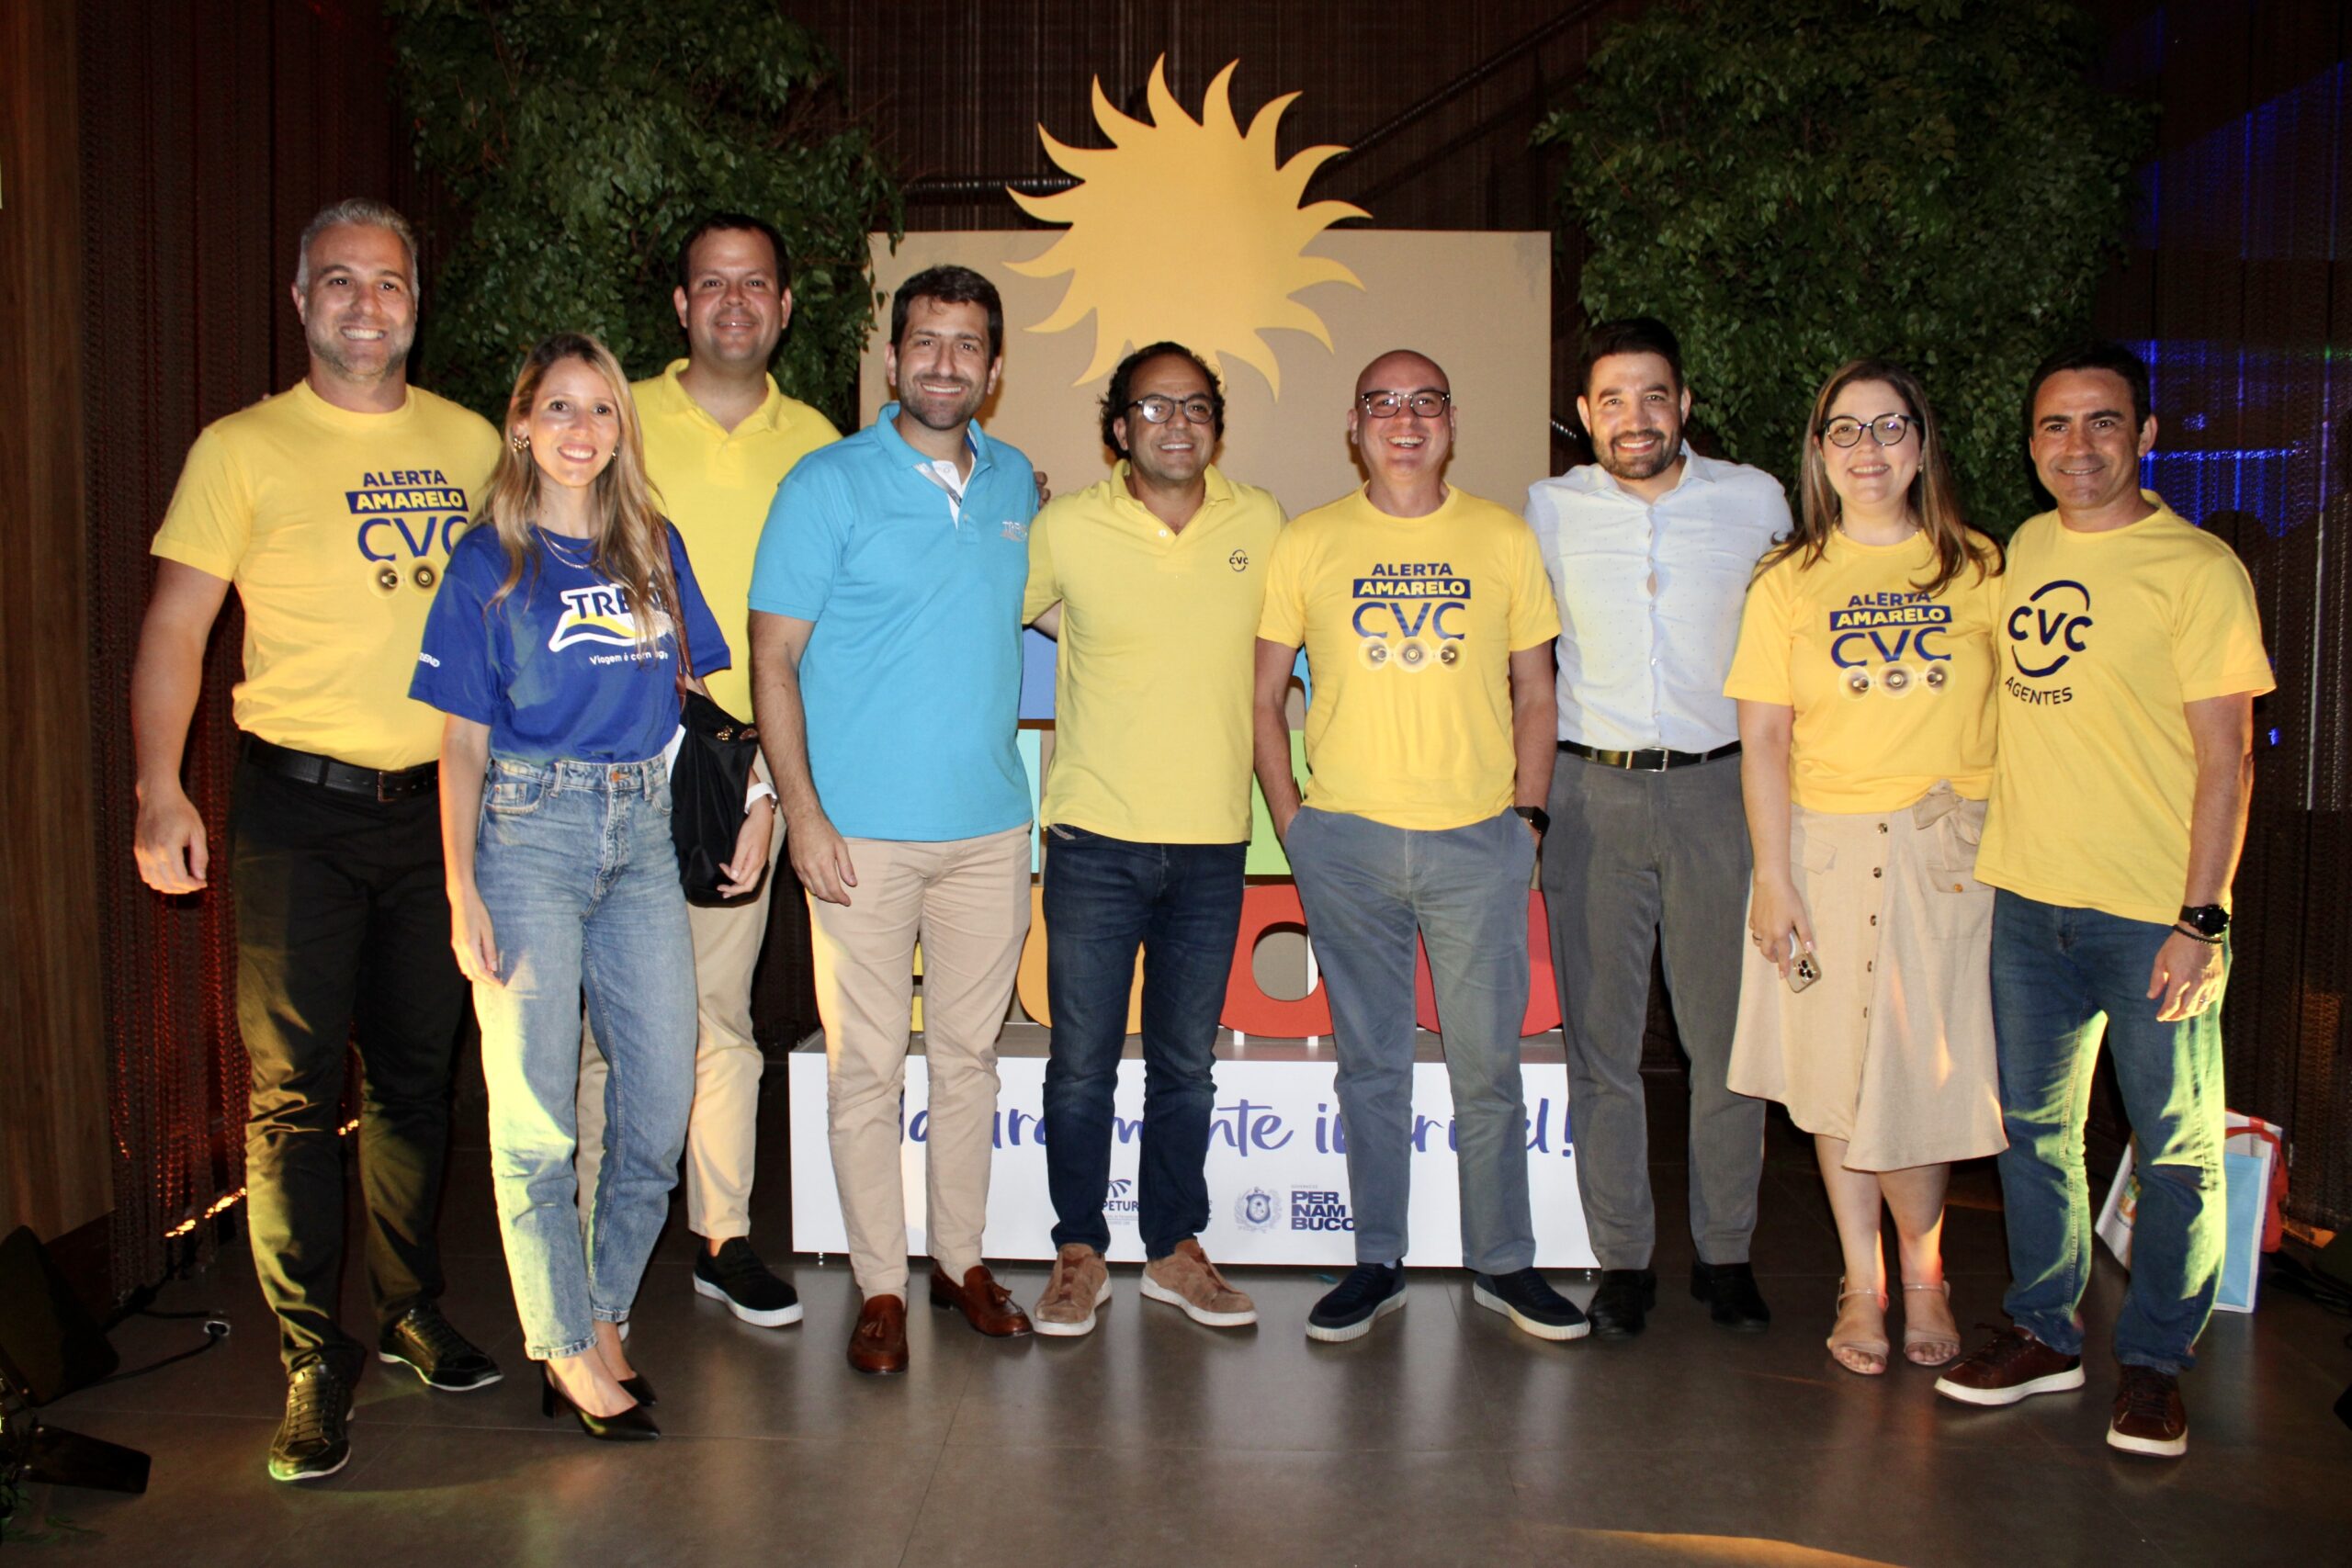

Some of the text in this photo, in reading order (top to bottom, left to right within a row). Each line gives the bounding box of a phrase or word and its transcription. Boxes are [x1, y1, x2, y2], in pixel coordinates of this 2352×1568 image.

[363, 470, 447, 487] ALERTA
[356, 491, 463, 510] AMARELO
[1228, 556, 1250, 565] CVC
[1372, 563, 1453, 576] ALERTA
[1359, 581, 1466, 596] AMARELO
[1848, 592, 1931, 608] ALERTA
[1351, 601, 1466, 640] CVC
[1837, 608, 1945, 627] AMARELO
[2007, 605, 2093, 652] CVC
[1831, 626, 1952, 669] CVC
[2005, 676, 2073, 705] AGENTES
[1291, 1190, 1340, 1204] PER
[1291, 1204, 1346, 1218] NAM
